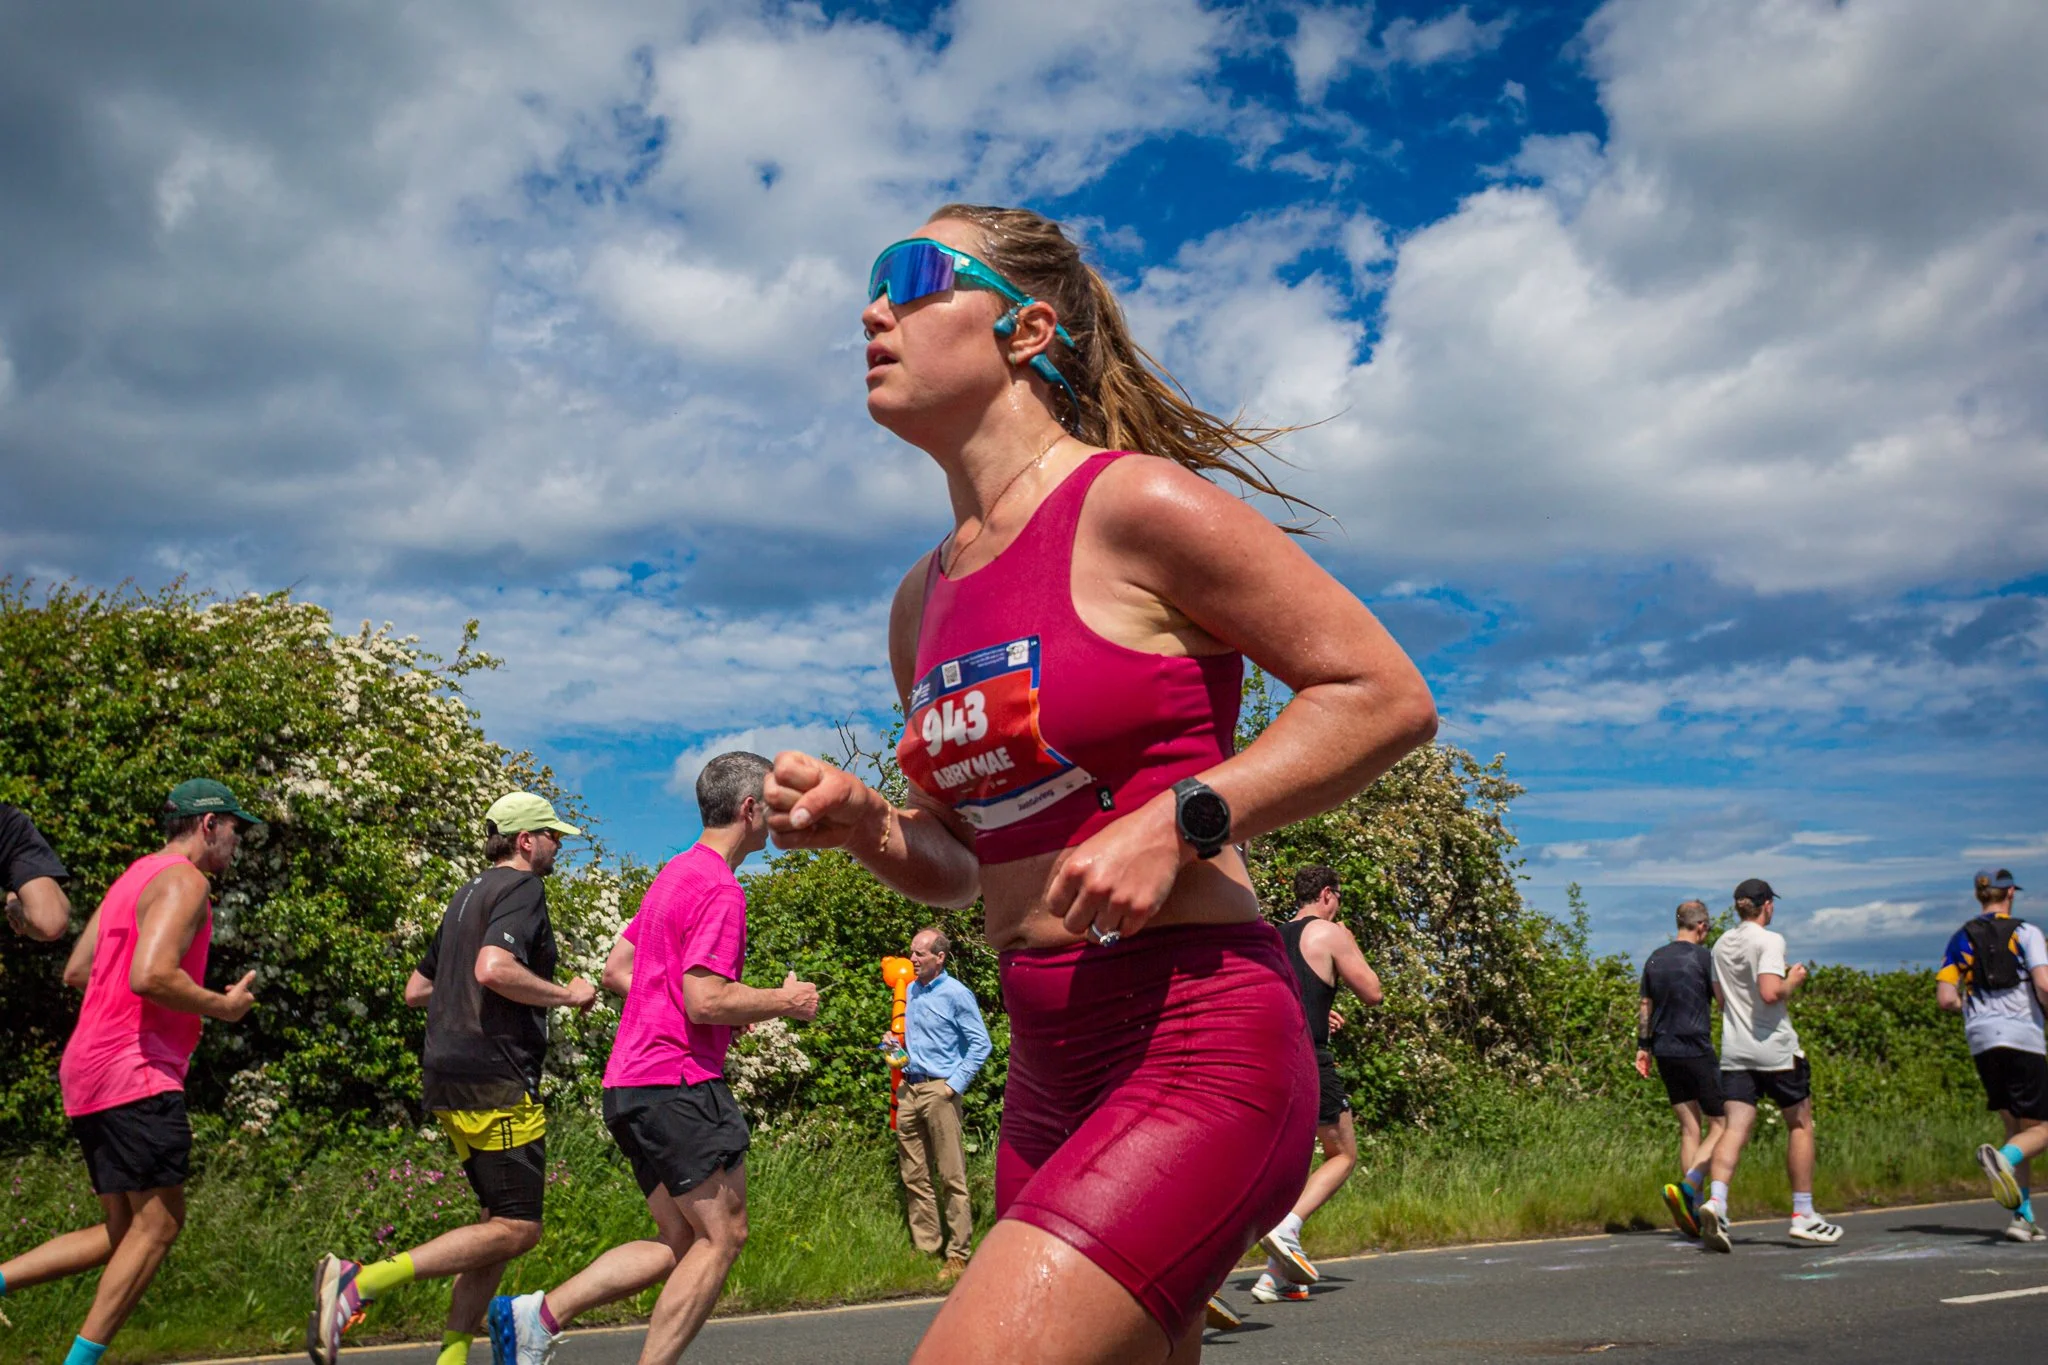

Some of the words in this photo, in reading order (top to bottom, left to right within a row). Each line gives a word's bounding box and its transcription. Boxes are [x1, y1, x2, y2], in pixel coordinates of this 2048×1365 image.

[922, 690, 989, 758] 943
[932, 759, 976, 790] ABBY
[971, 746, 1016, 777] MAE
